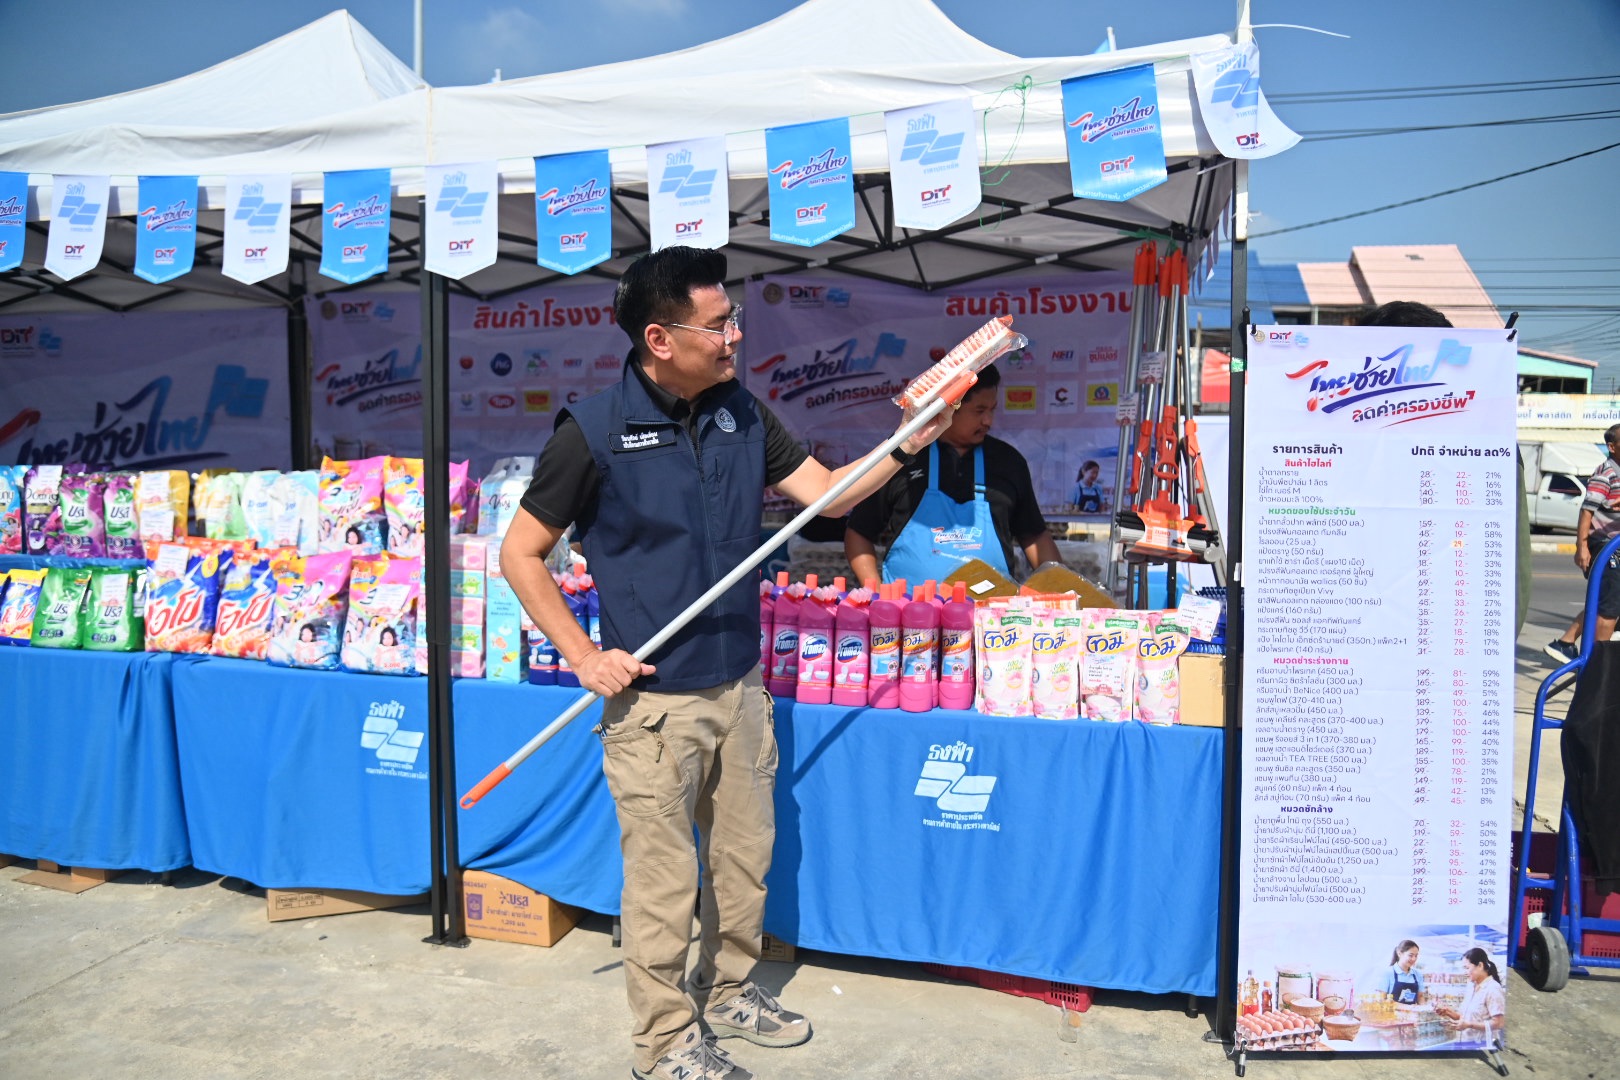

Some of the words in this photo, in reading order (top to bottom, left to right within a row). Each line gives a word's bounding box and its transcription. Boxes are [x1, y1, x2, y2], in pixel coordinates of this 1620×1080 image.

[907, 112, 936, 131] ธงฟ้า
[1069, 97, 1156, 142] ไทยช่วยไทย
[665, 148, 692, 166] ธงฟ้า
[770, 148, 847, 189] ไทยช่วยไทย
[1100, 156, 1135, 174] DiT
[539, 179, 607, 216] ไทยช่วยไทย
[920, 184, 952, 200] DiT
[140, 200, 194, 232] ไทยช่วยไทย
[326, 195, 388, 229] ไทยช่วยไทย
[796, 203, 827, 218] DiT
[675, 218, 704, 234] DiT
[448, 239, 474, 251] DiT
[560, 232, 588, 245] DiT
[65, 245, 86, 256] DiT
[155, 248, 176, 259] DiT
[245, 246, 268, 258] DiT
[343, 245, 368, 257] DiT
[788, 285, 826, 298] DiT
[341, 301, 373, 315] DiT
[473, 298, 617, 329] สินค้าโรงงา
[1269, 331, 1292, 341] DiT
[751, 336, 888, 400] ไทยช่วยไทย
[1285, 341, 1450, 412] ไทยช่วยไทย
[1352, 391, 1474, 422] ลดค่าครองชีพ
[1272, 443, 1344, 455] รายการสินค้า
[1411, 446, 1435, 456] ปกติ
[1438, 446, 1482, 457] จำหน่าย
[1484, 448, 1511, 457] ลด%
[1485, 489, 1502, 497] 21%
[1484, 530, 1503, 538] 58%
[1484, 540, 1503, 548] 53%
[1483, 569, 1502, 577] 33%
[1483, 579, 1502, 587] 29%
[1483, 618, 1502, 626] 23%
[983, 626, 1020, 649] โทมิ
[1483, 628, 1500, 636] 18%
[1033, 631, 1067, 651] โทมิ
[1086, 631, 1125, 653] โทมิ
[1139, 635, 1177, 657] โทมิ
[801, 641, 827, 657] Promax
[837, 643, 864, 659] Promax
[1273, 656, 1349, 666] หมวดชำระร่างกาย
[1482, 669, 1501, 677] 59%
[1482, 679, 1501, 687] 52%
[1293, 687, 1320, 695] BeNice
[368, 699, 406, 720] ธงฟ้า
[927, 740, 975, 763] ธงฟ้า
[1289, 755, 1306, 763] TEA
[1307, 755, 1329, 763] TREE
[1481, 757, 1499, 765] 35%
[1280, 804, 1333, 813] หมวดซักล้าง
[732, 1010, 750, 1023] N
[671, 1065, 691, 1080] N
